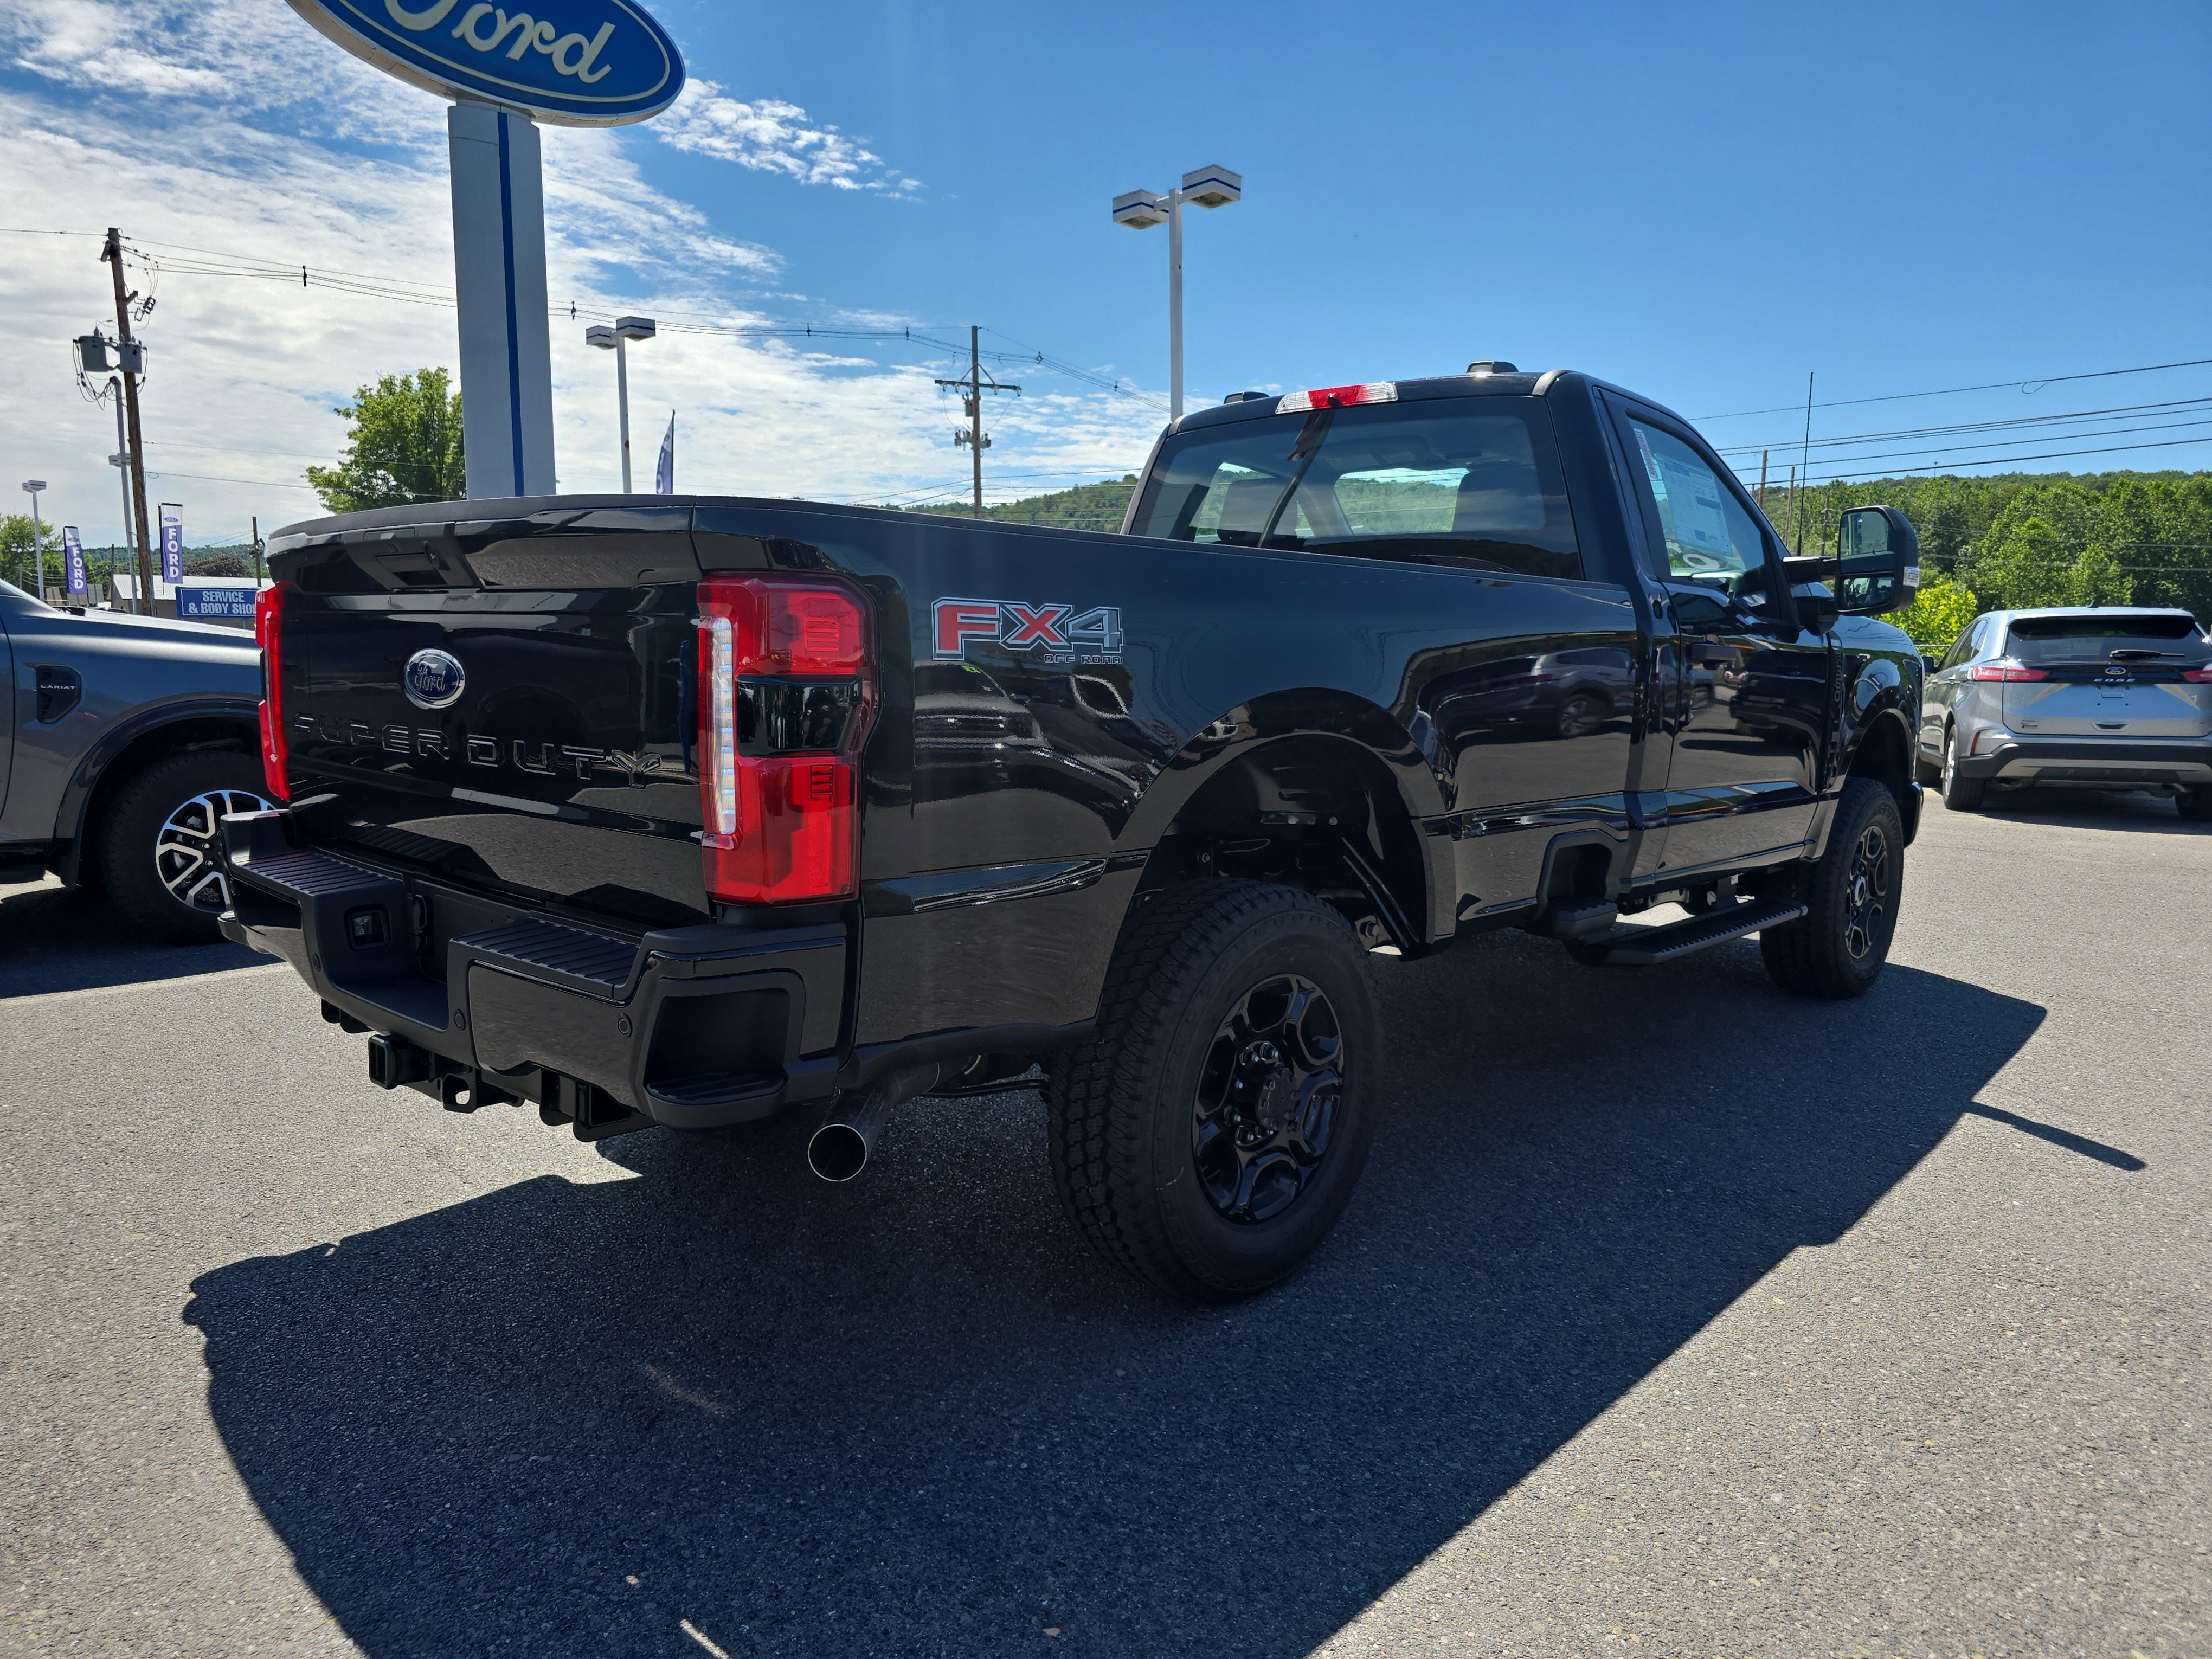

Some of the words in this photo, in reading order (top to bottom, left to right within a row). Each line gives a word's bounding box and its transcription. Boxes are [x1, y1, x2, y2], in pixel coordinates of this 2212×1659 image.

[72, 546, 84, 589] FORD
[168, 528, 179, 578] FORD
[188, 602, 198, 614] &
[201, 603, 229, 614] BODY
[202, 590, 245, 603] SERVICE
[931, 597, 1123, 661] FX4
[414, 660, 446, 692] Ford
[1044, 654, 1076, 664] OFF
[1081, 655, 1123, 665] ROAD
[294, 712, 450, 760] SUPER
[466, 734, 662, 789] DUTY
